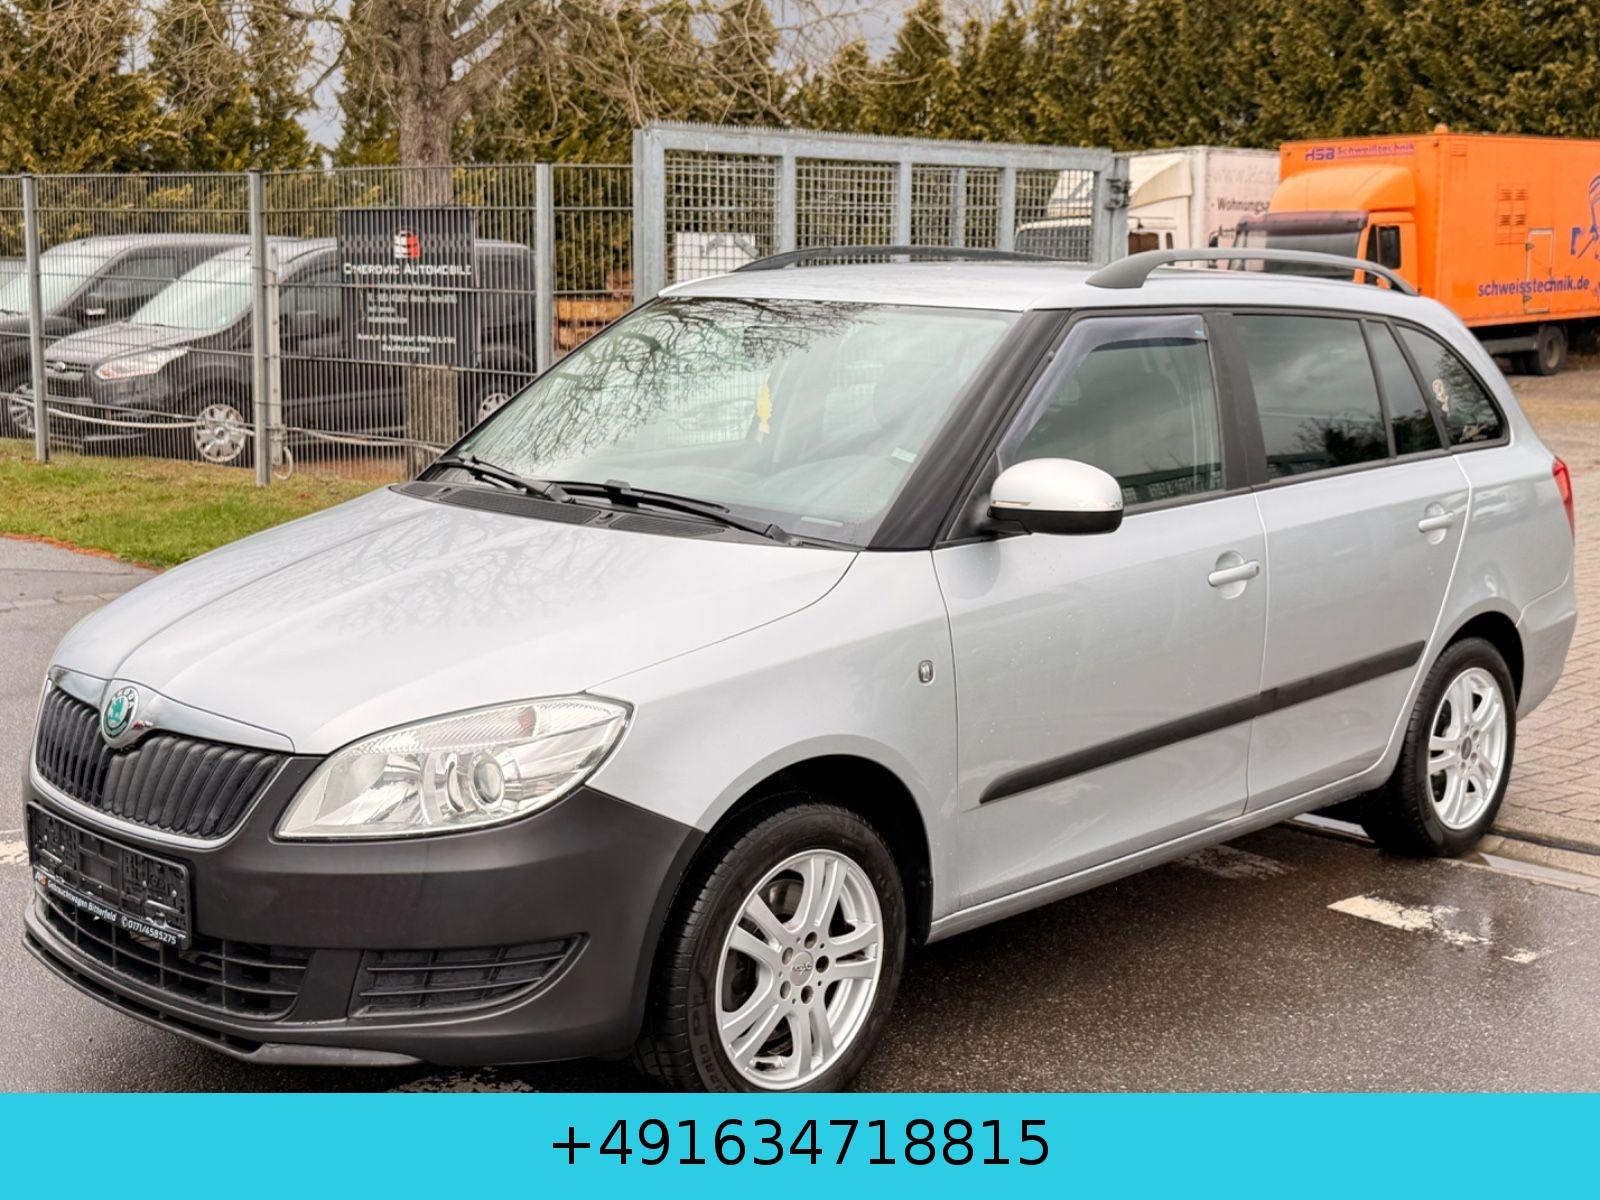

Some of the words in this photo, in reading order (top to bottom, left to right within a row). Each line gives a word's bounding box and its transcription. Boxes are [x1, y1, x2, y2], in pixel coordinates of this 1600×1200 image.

[1305, 147, 1336, 161] HSB
[1478, 275, 1590, 297] schweisstechnik.de
[87, 901, 118, 922] Bitterfeld
